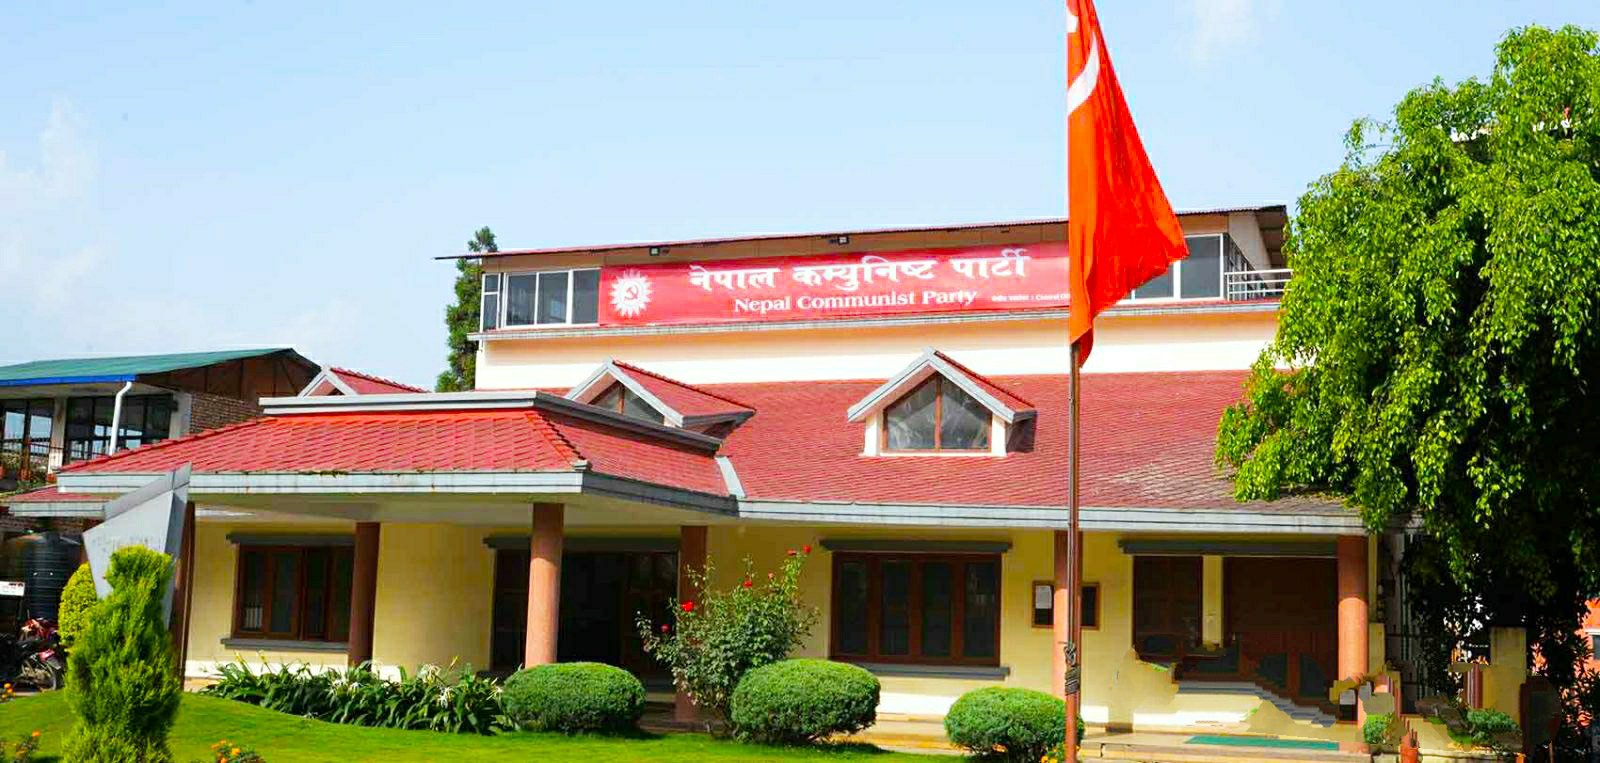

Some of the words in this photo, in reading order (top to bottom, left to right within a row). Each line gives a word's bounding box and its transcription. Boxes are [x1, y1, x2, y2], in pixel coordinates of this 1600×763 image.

[689, 264, 780, 291] नेपाल
[792, 255, 938, 292] कम्युनिष्ट
[949, 247, 1031, 278] पार्टी
[733, 296, 790, 315] Nepal
[797, 289, 915, 310] Communist
[921, 289, 977, 306] Party
